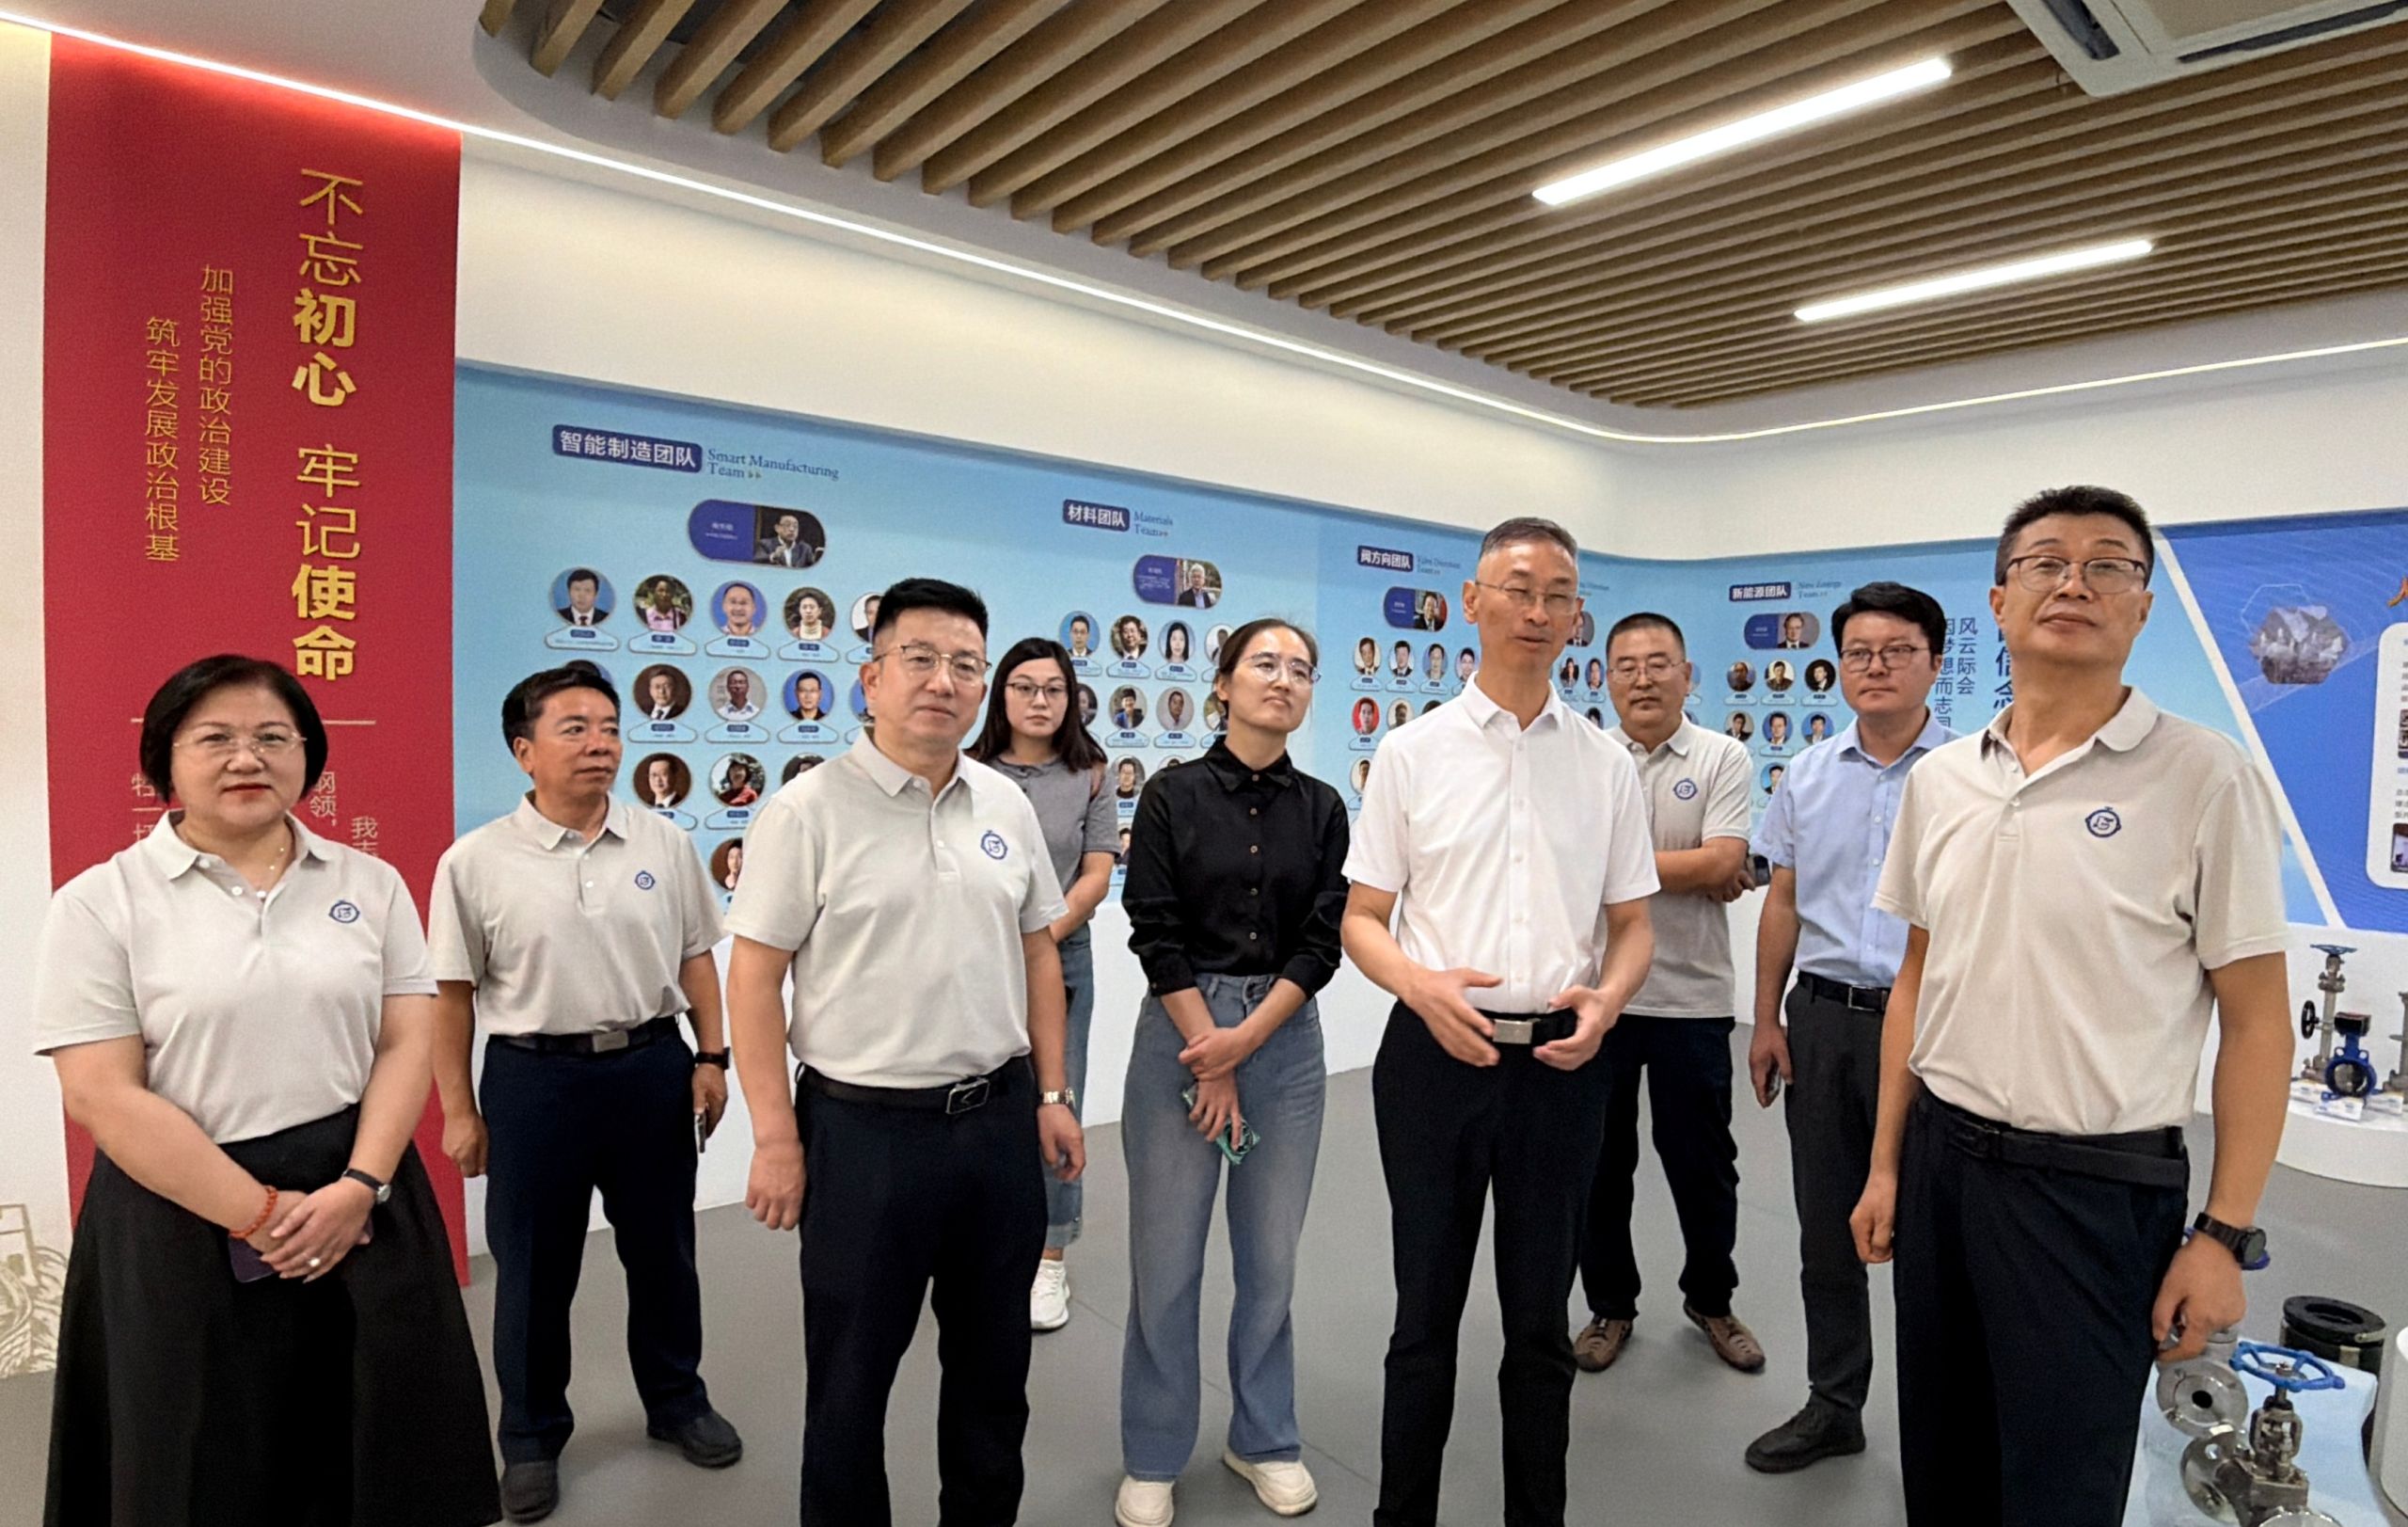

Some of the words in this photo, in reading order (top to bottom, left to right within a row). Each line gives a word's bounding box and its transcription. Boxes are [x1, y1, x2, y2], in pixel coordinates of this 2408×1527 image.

[292, 167, 363, 408] 不忘初心
[198, 264, 234, 506] 加强党的政治建设
[145, 316, 181, 562] 筑牢发展政治根基
[560, 430, 696, 468] 智能制造团队
[707, 448, 746, 467] Smart
[749, 453, 840, 481] Manufacturing
[707, 462, 746, 479] Team
[1067, 503, 1127, 528] 材料团队
[292, 444, 362, 680] 牢记使命
[1732, 584, 1787, 599] 新能源团队
[1956, 616, 1979, 695] 风云际会
